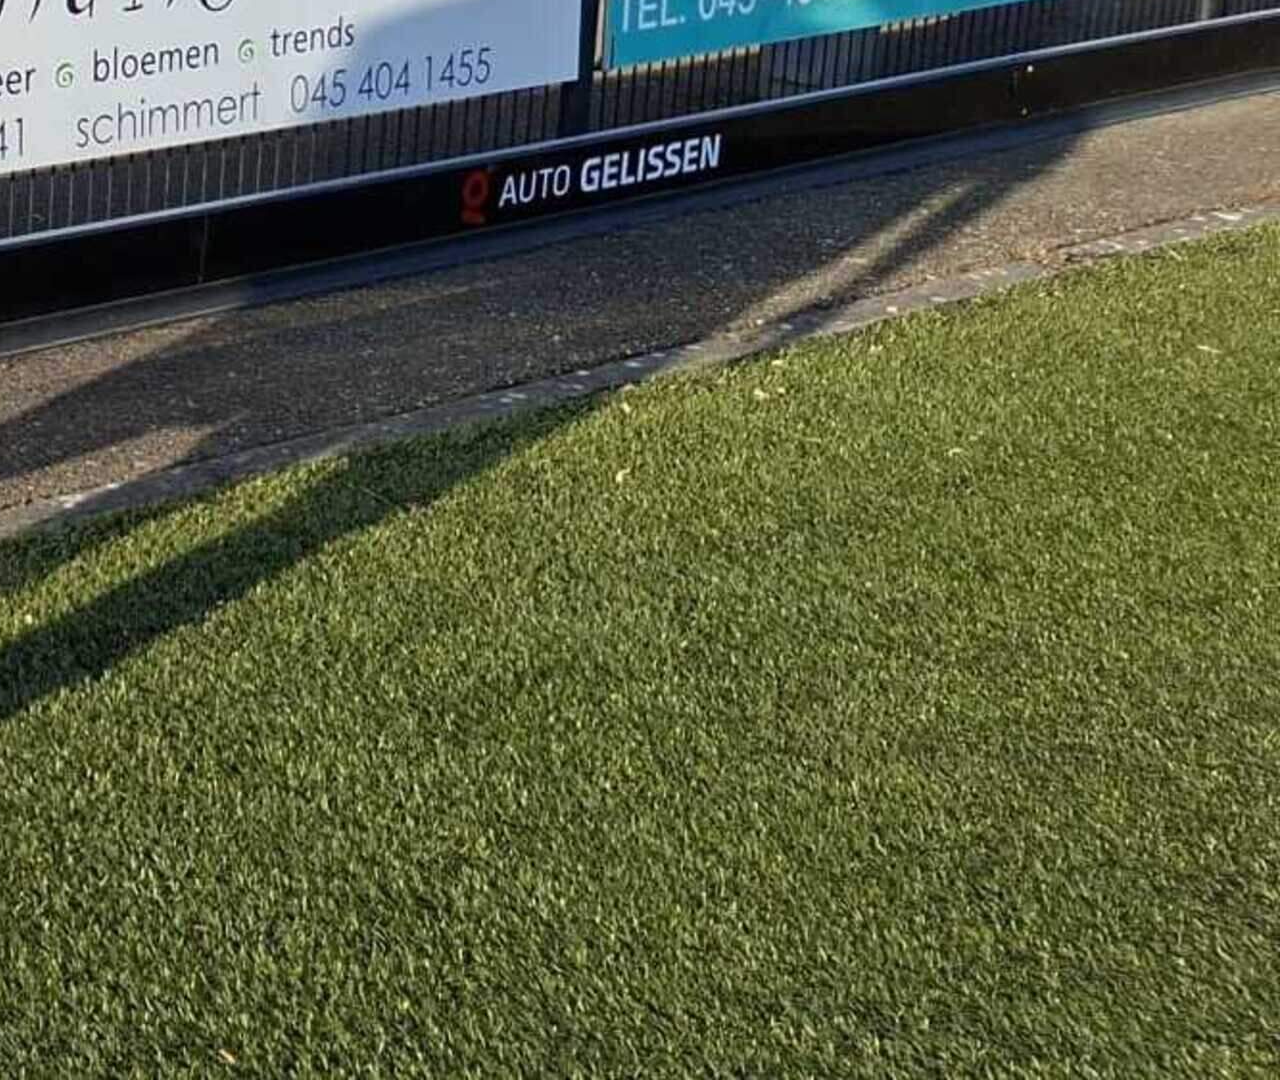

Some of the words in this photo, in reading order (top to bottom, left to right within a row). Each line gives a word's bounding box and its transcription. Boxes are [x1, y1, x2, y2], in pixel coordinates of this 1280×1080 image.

[93, 40, 219, 83] bloemen
[270, 16, 356, 58] trends
[76, 83, 262, 149] schimmert
[290, 69, 347, 114] 045
[357, 60, 410, 103] 404
[423, 47, 492, 92] 1455
[498, 165, 571, 208] AUTO
[580, 134, 722, 193] GELISSEN
